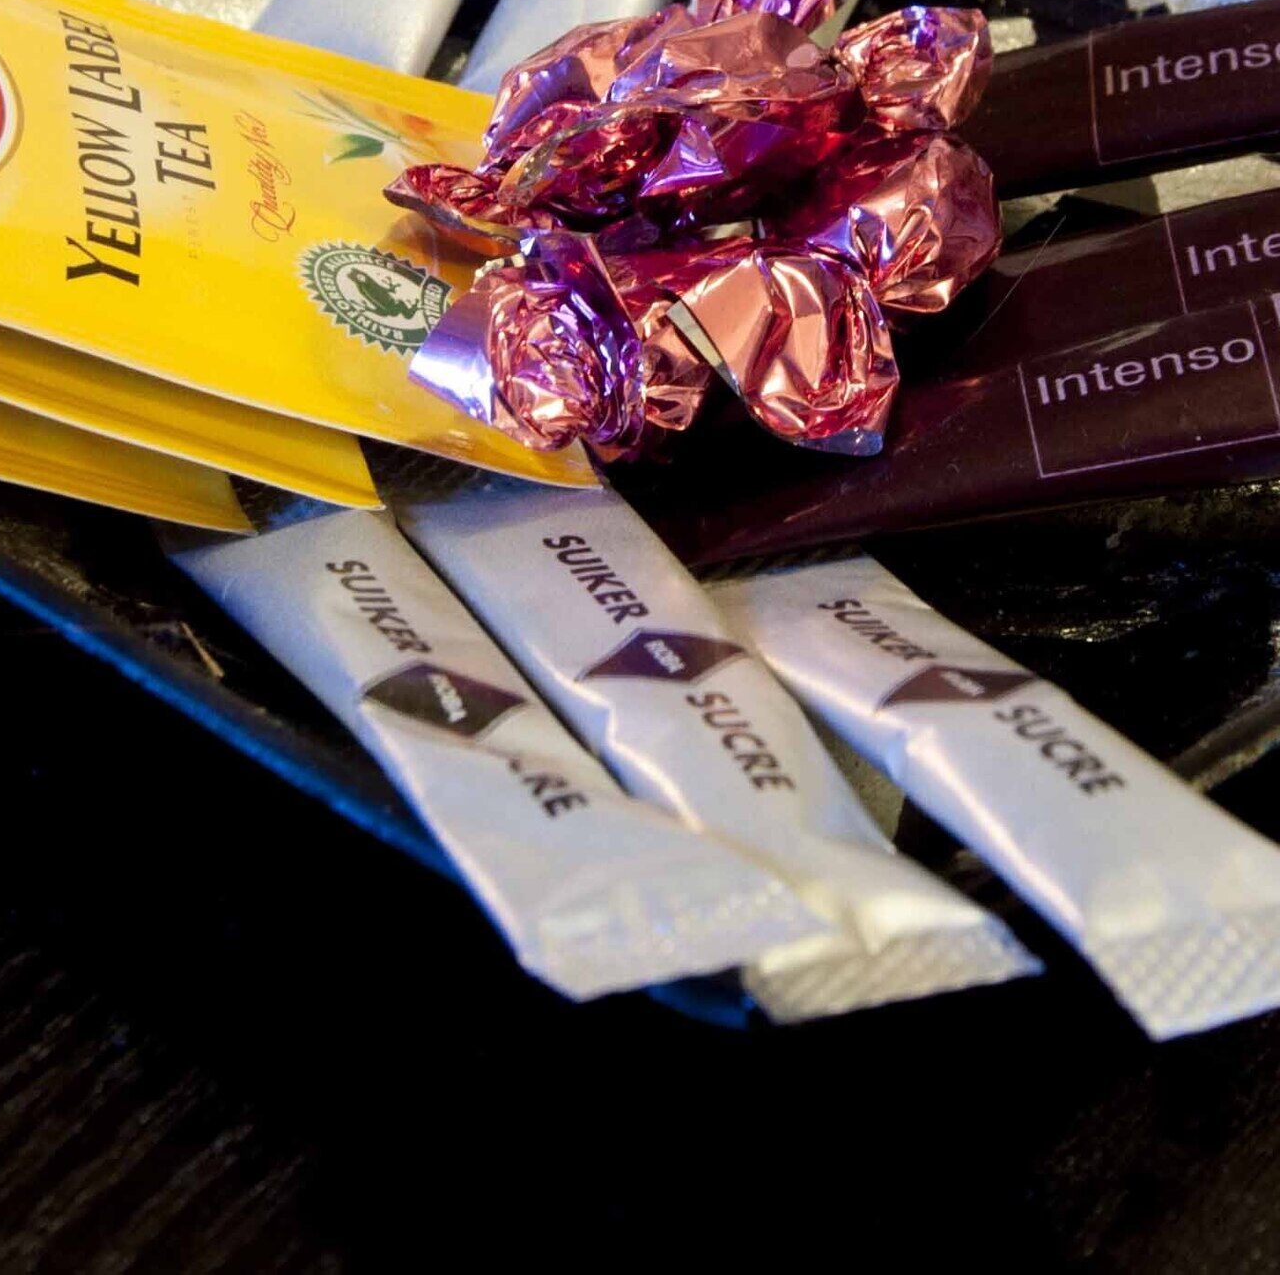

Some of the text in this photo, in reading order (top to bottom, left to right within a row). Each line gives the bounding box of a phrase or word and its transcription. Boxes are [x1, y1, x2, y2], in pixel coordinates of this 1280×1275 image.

[65, 111, 142, 287] YELLOW
[153, 120, 217, 191] TEA
[320, 268, 406, 341] RAINFOREST
[1036, 336, 1257, 407] Intenso
[324, 559, 432, 653] SUIKER
[542, 534, 650, 625] SUIKER
[685, 691, 797, 792] SUCRE
[992, 703, 1127, 797] SUCRE
